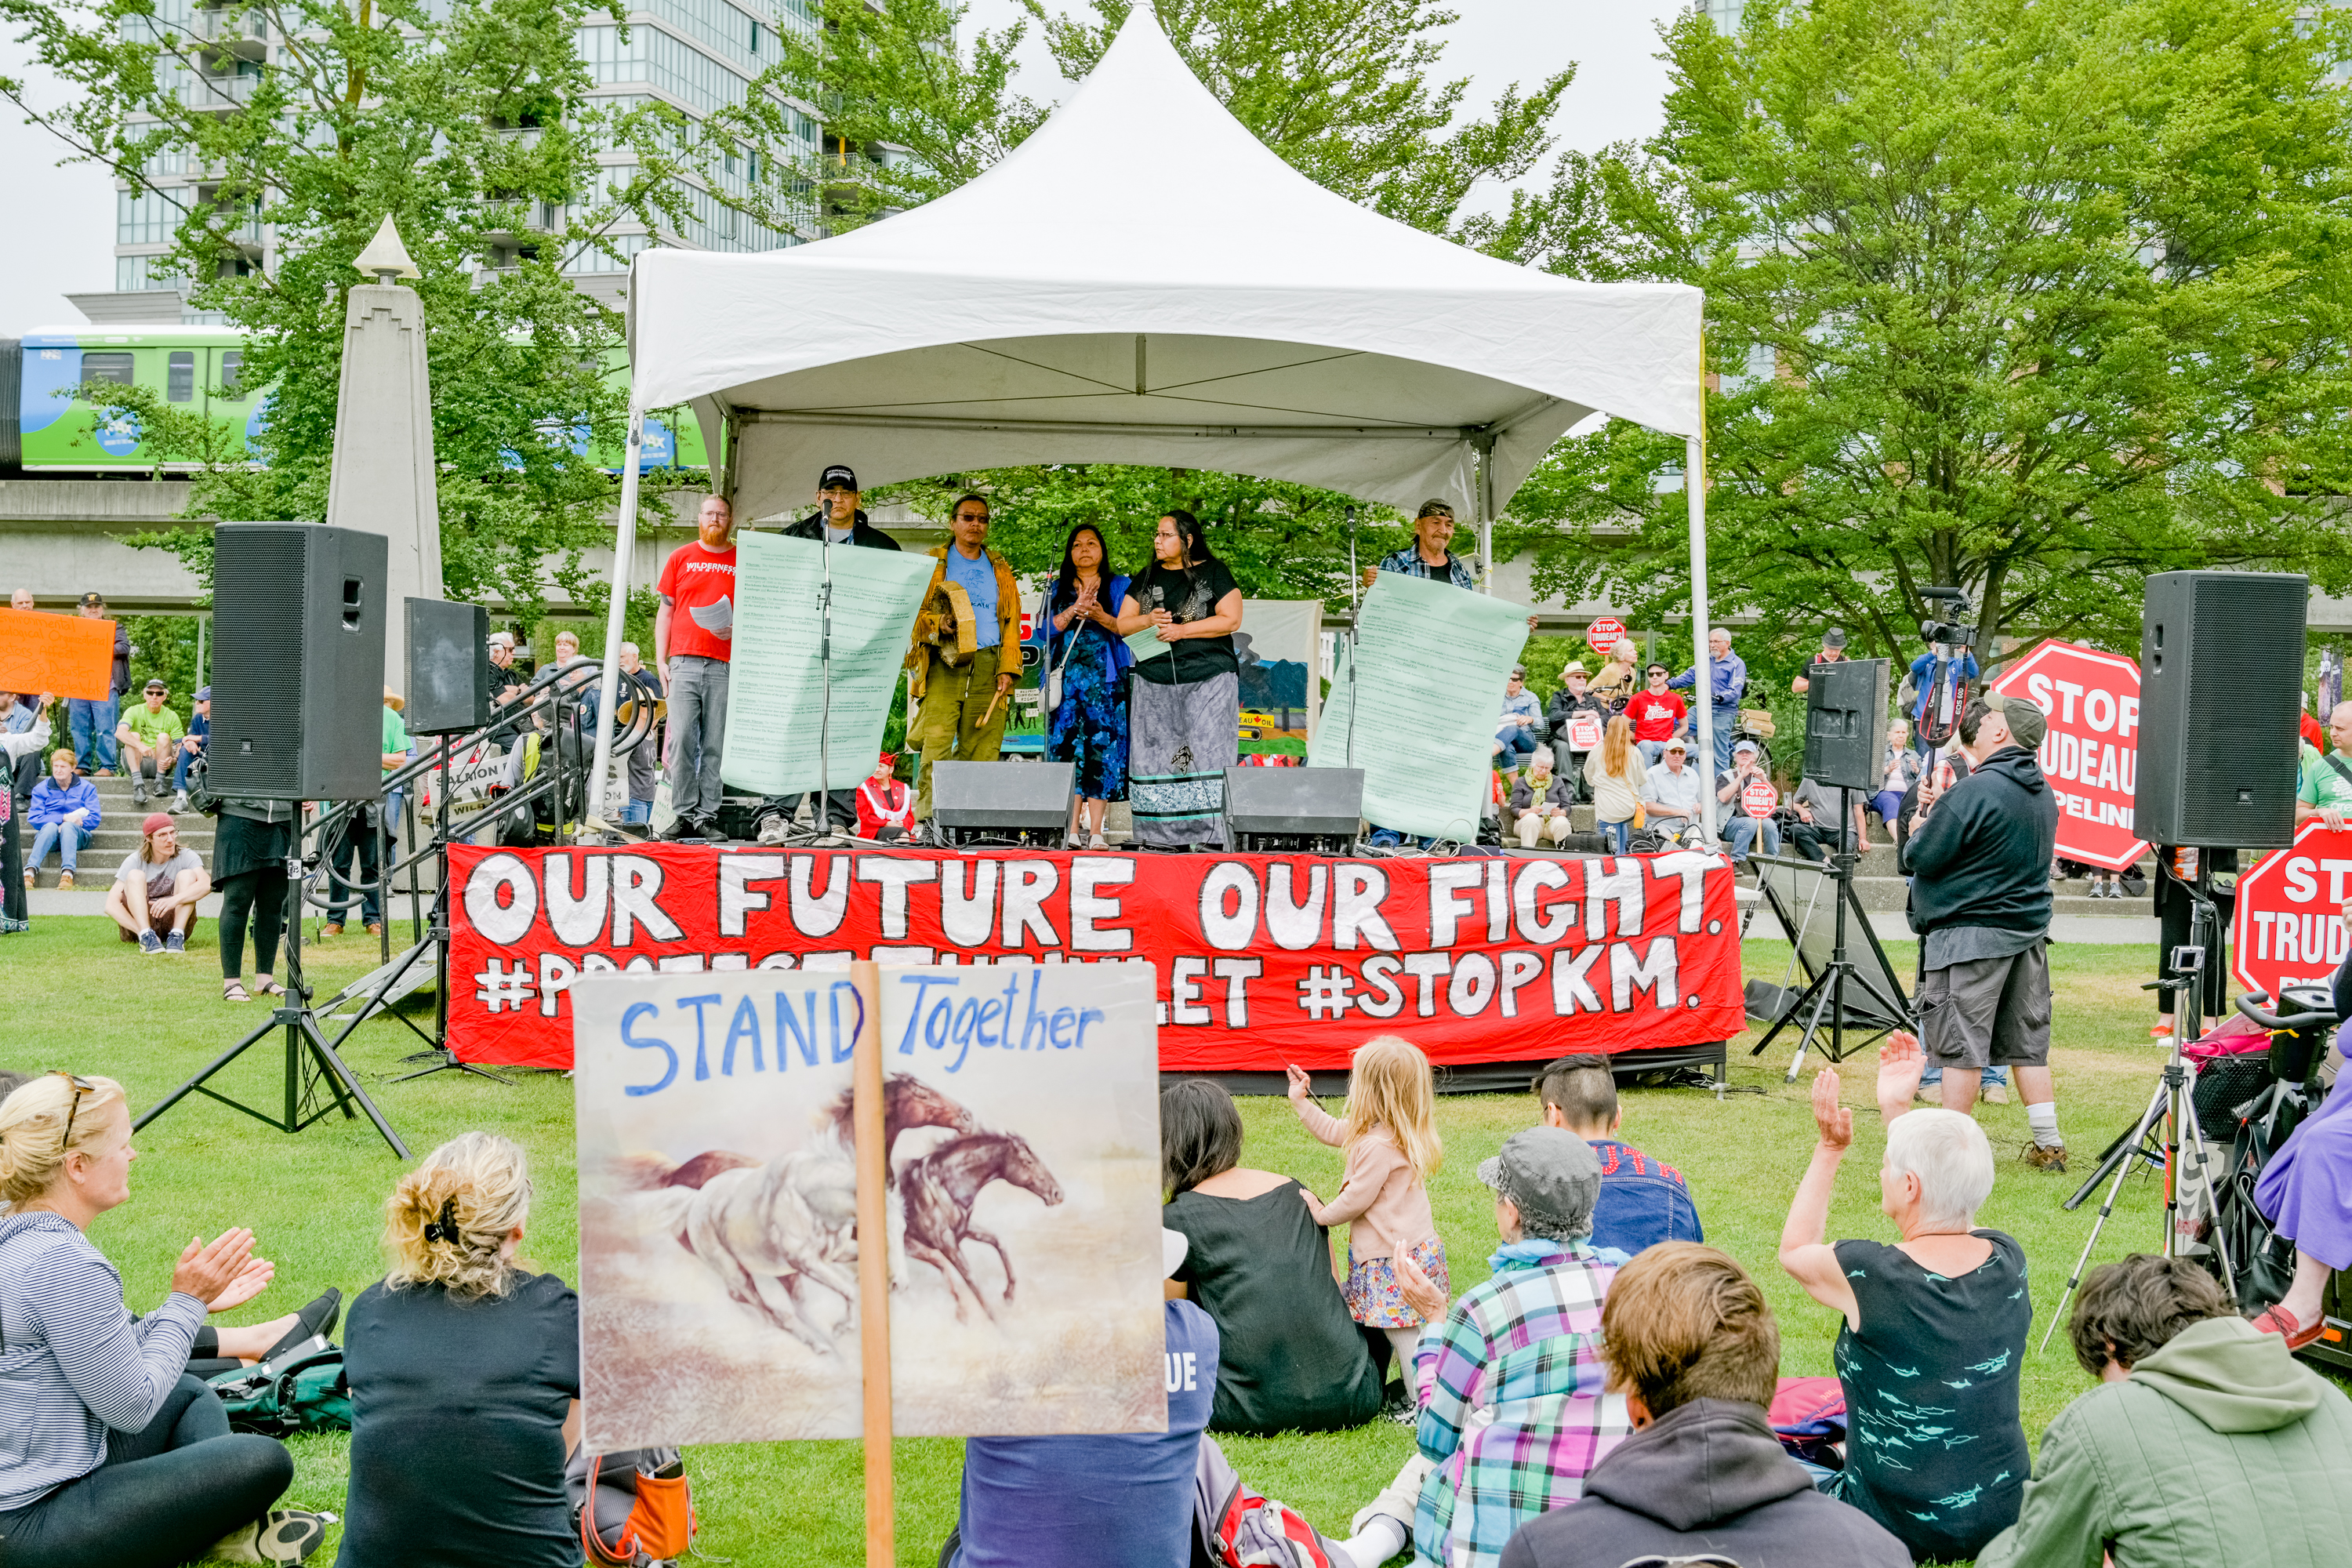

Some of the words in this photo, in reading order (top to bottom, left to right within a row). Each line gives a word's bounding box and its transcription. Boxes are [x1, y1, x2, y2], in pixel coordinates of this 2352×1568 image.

[687, 562, 736, 572] WILDERNESS
[0, 626, 44, 641] cological
[49, 630, 108, 649] Organizational
[1592, 632, 1622, 641] TRUDEAU'S
[1595, 623, 1617, 632] STOP
[0, 642, 32, 656] actors
[40, 645, 78, 659] Affect
[49, 660, 94, 679] Disaster
[45, 676, 78, 695] People
[2027, 673, 2140, 738] STOP
[2037, 729, 2136, 796] UDEAU
[436, 765, 498, 786] SALMON
[1746, 796, 1773, 806] TRUDEAU'S
[2053, 789, 2134, 830] PELIN
[463, 852, 686, 947] OUR
[717, 852, 1137, 953] FUTURE
[1199, 861, 1401, 951] OUR
[1428, 851, 1726, 949] FIGHT.
[1298, 936, 1701, 1021] #STOPKM.
[620, 980, 865, 1098] STAND
[899, 969, 1105, 1073] Together
